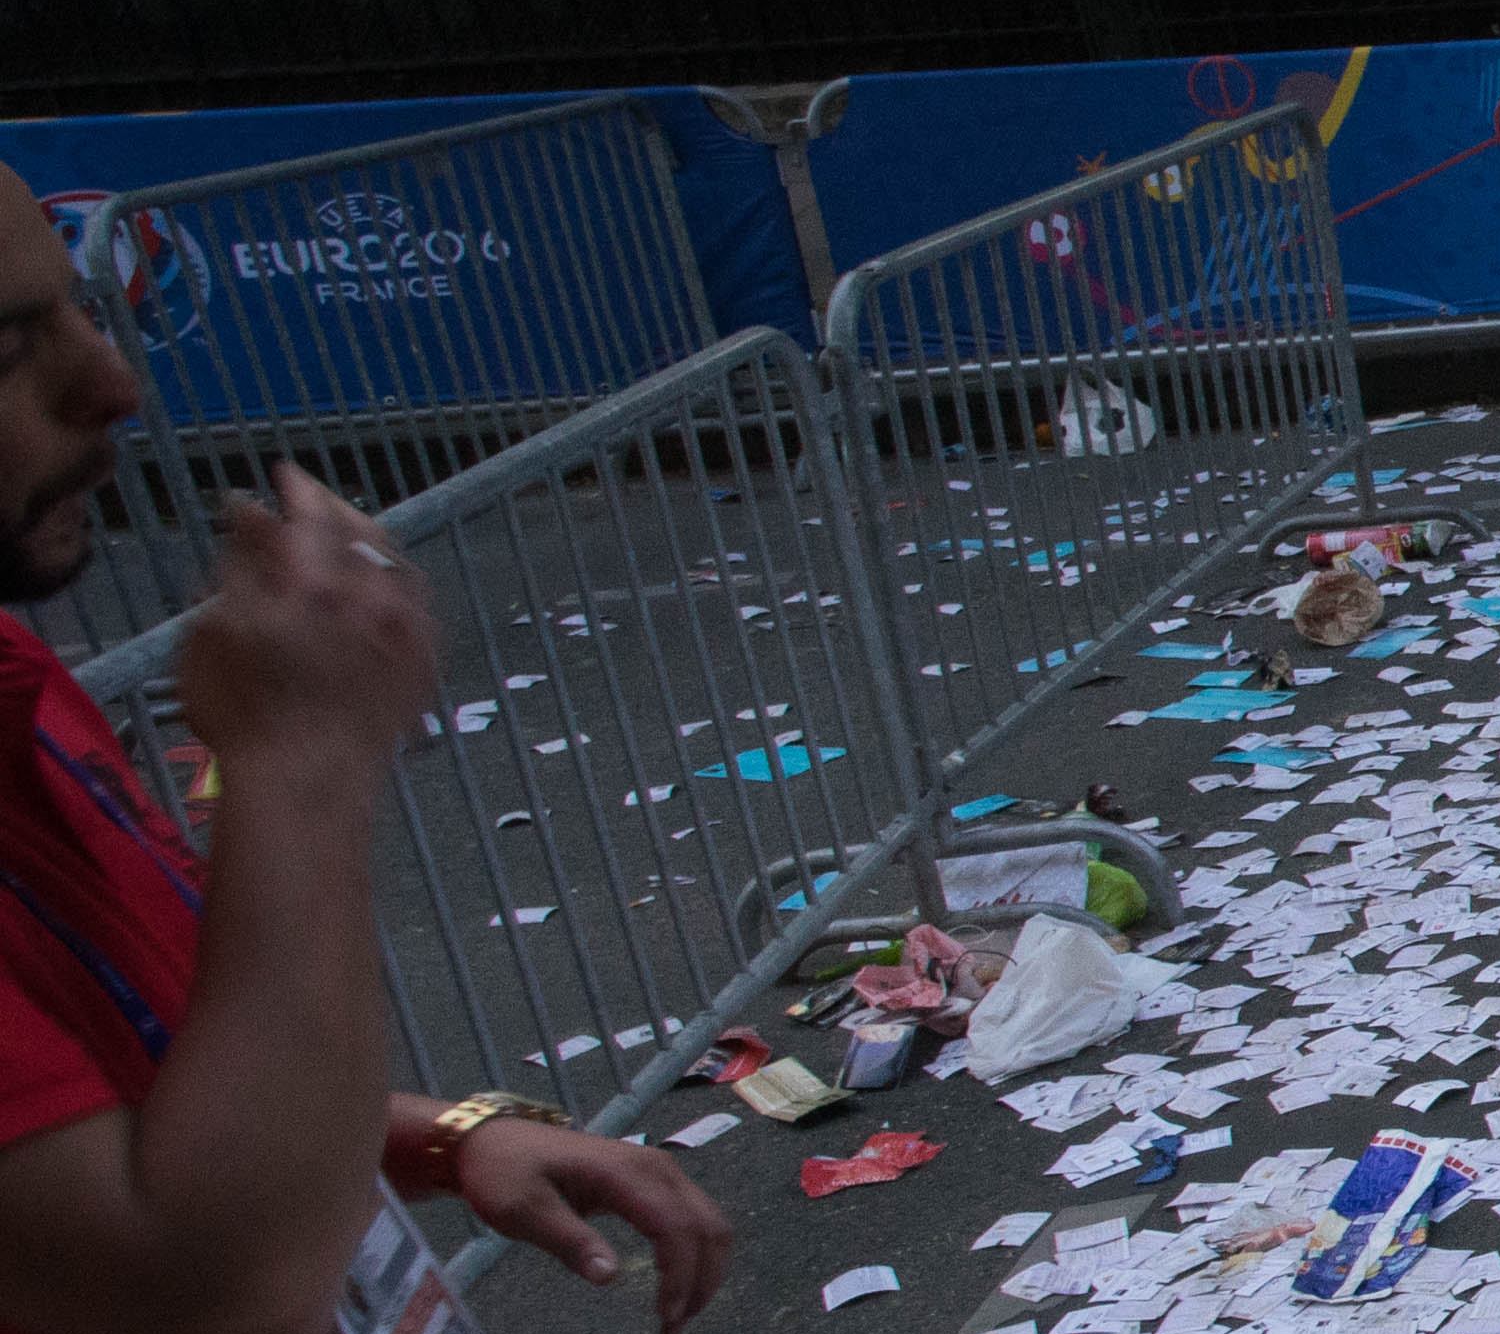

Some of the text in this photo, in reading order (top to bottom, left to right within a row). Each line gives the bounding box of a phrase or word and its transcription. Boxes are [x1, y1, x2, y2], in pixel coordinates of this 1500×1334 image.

[319, 199, 405, 228] UEFA
[231, 229, 512, 279] EURO206
[316, 274, 454, 305] FRANCE
